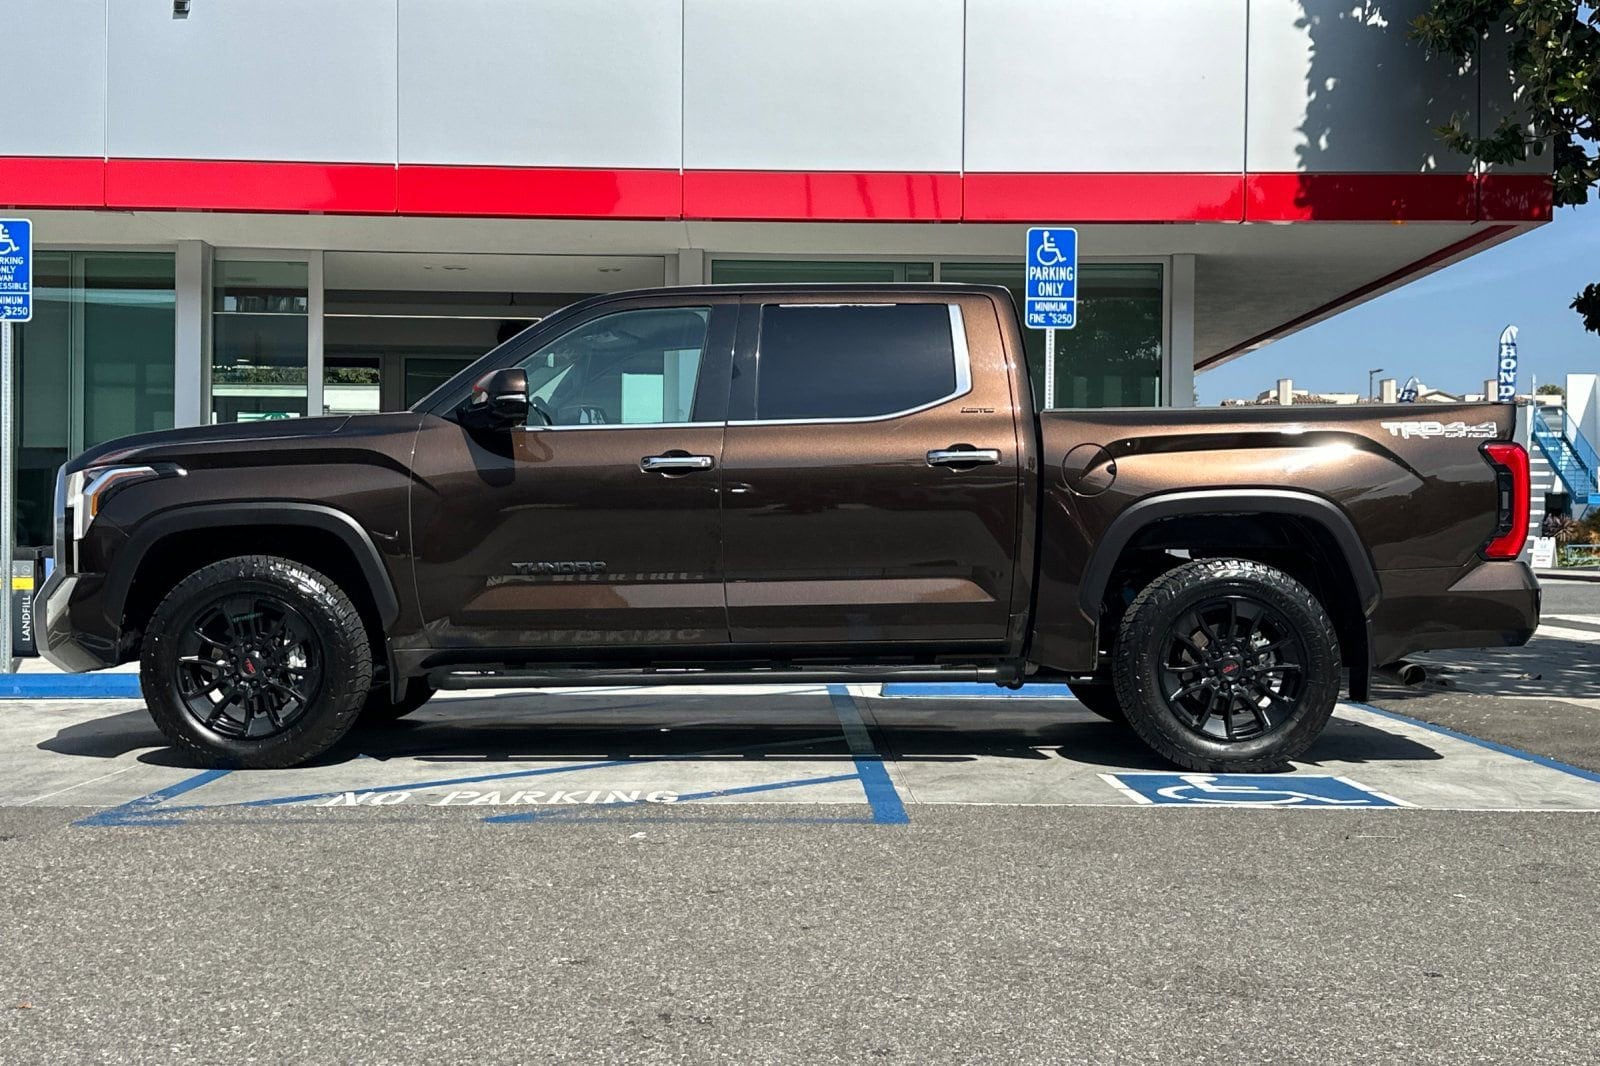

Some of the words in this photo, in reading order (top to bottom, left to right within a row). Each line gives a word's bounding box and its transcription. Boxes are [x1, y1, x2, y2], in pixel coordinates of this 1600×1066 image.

[0, 257, 24, 265] RKING
[0, 266, 16, 274] NLY
[1029, 266, 1074, 281] PARKING
[0, 282, 28, 290] ESSIBLE
[1038, 282, 1065, 297] ONLY
[1034, 302, 1068, 312] MINIMUM
[1029, 313, 1046, 324] FINE
[1499, 345, 1517, 401] HOND
[1380, 421, 1445, 439] TRD
[22, 595, 31, 641] LANDFILL
[318, 791, 412, 807] NO
[434, 790, 679, 806] PARKING
